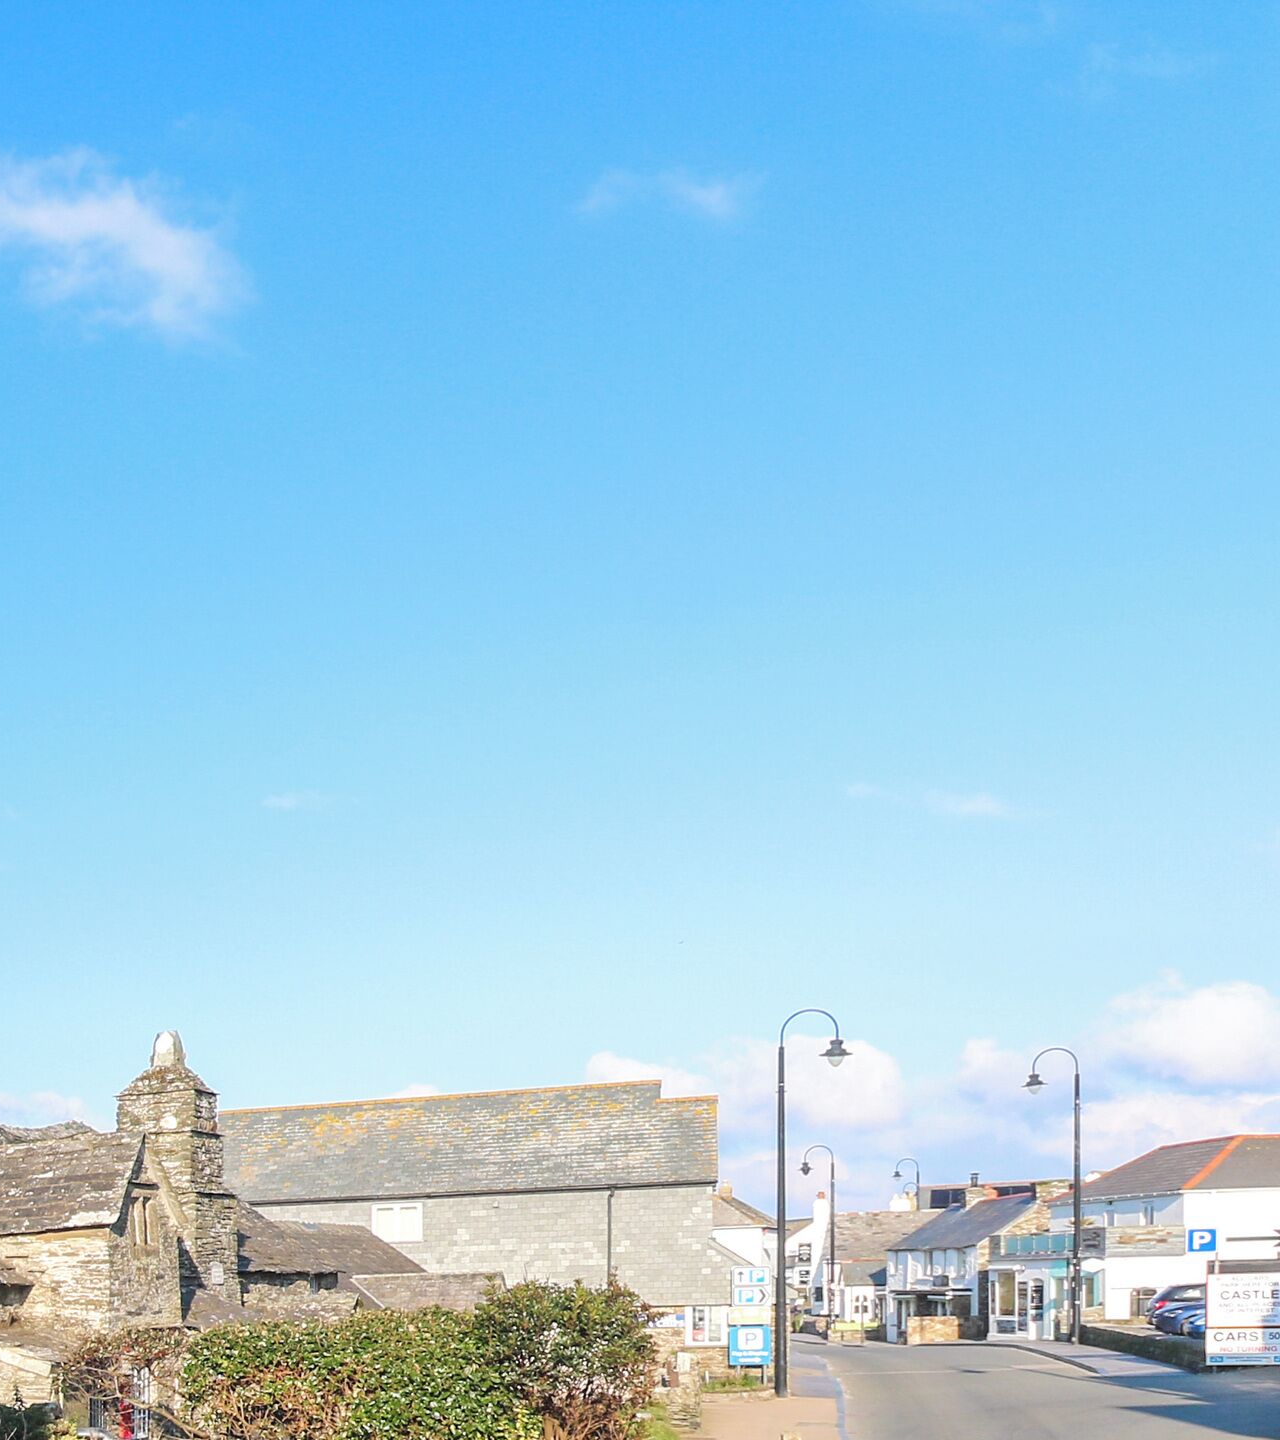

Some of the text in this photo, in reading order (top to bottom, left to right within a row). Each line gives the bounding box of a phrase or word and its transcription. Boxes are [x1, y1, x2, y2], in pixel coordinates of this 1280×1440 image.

[1192, 1231, 1212, 1250] P
[1220, 1289, 1280, 1300] CASTLE
[745, 1332, 757, 1346] P
[1213, 1331, 1259, 1342] CARS
